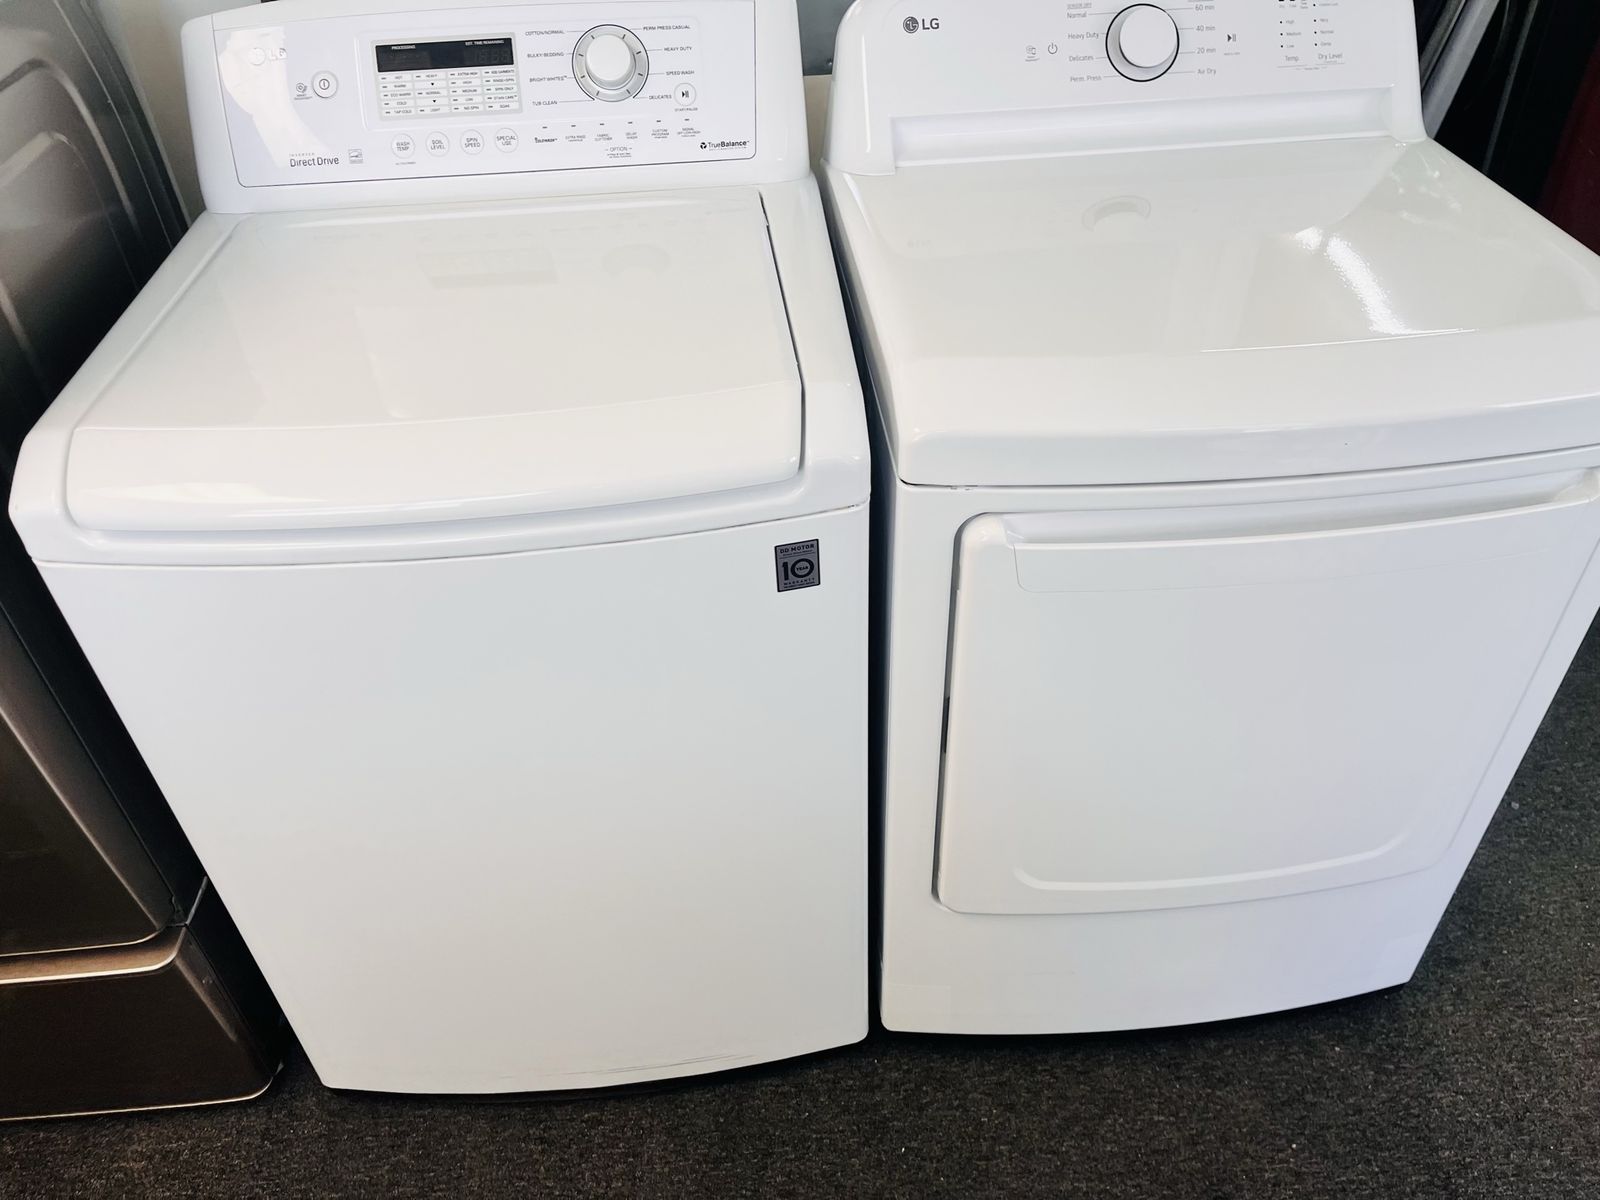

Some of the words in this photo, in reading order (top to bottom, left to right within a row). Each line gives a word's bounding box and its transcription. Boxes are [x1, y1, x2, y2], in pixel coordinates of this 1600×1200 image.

[922, 18, 940, 30] LG
[1086, 31, 1100, 39] Duty
[290, 157, 316, 167] Direct
[317, 156, 340, 165] Drive
[782, 558, 814, 581] 10
[784, 577, 815, 585] WARRANTY
